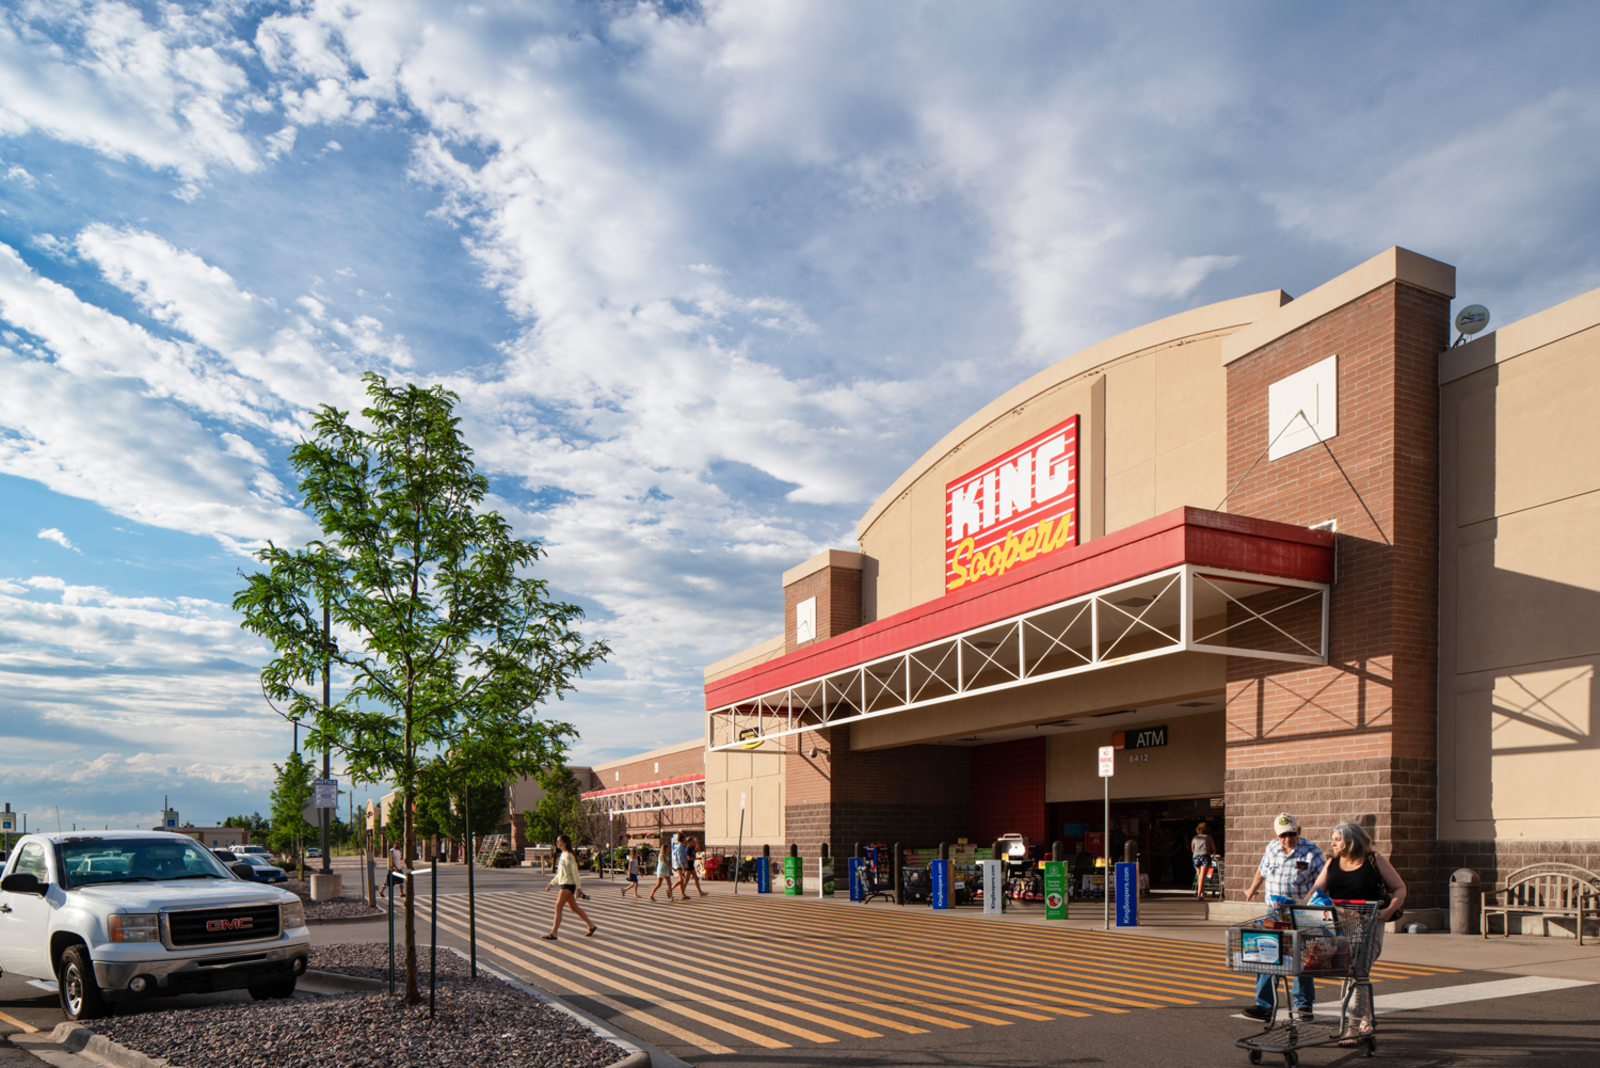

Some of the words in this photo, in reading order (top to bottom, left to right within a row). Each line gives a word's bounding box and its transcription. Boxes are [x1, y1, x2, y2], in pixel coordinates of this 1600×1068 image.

[951, 434, 1069, 543] KING
[948, 513, 1072, 590] Soopers
[1136, 730, 1164, 747] ATM
[1129, 754, 1148, 762] 6412
[1123, 867, 1131, 924] KingSoopers.com
[206, 917, 253, 931] GMC
